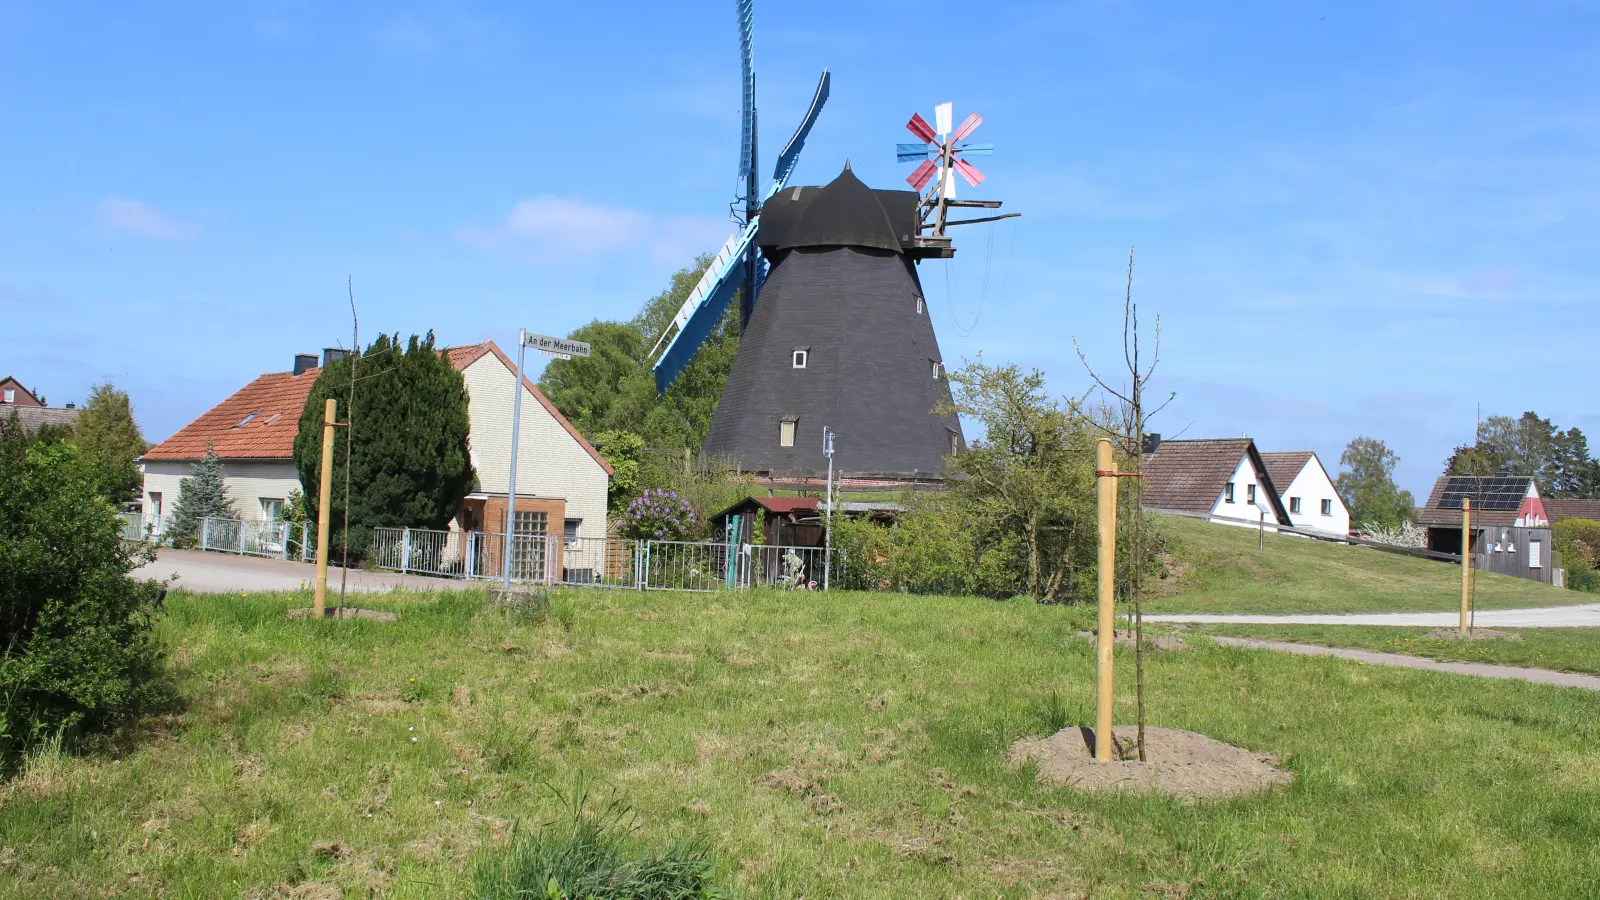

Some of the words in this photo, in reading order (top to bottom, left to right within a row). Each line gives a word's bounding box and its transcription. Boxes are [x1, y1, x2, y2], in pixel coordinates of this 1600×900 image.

[528, 336, 537, 345] An
[540, 338, 551, 347] der
[553, 340, 588, 354] Meerbahn
